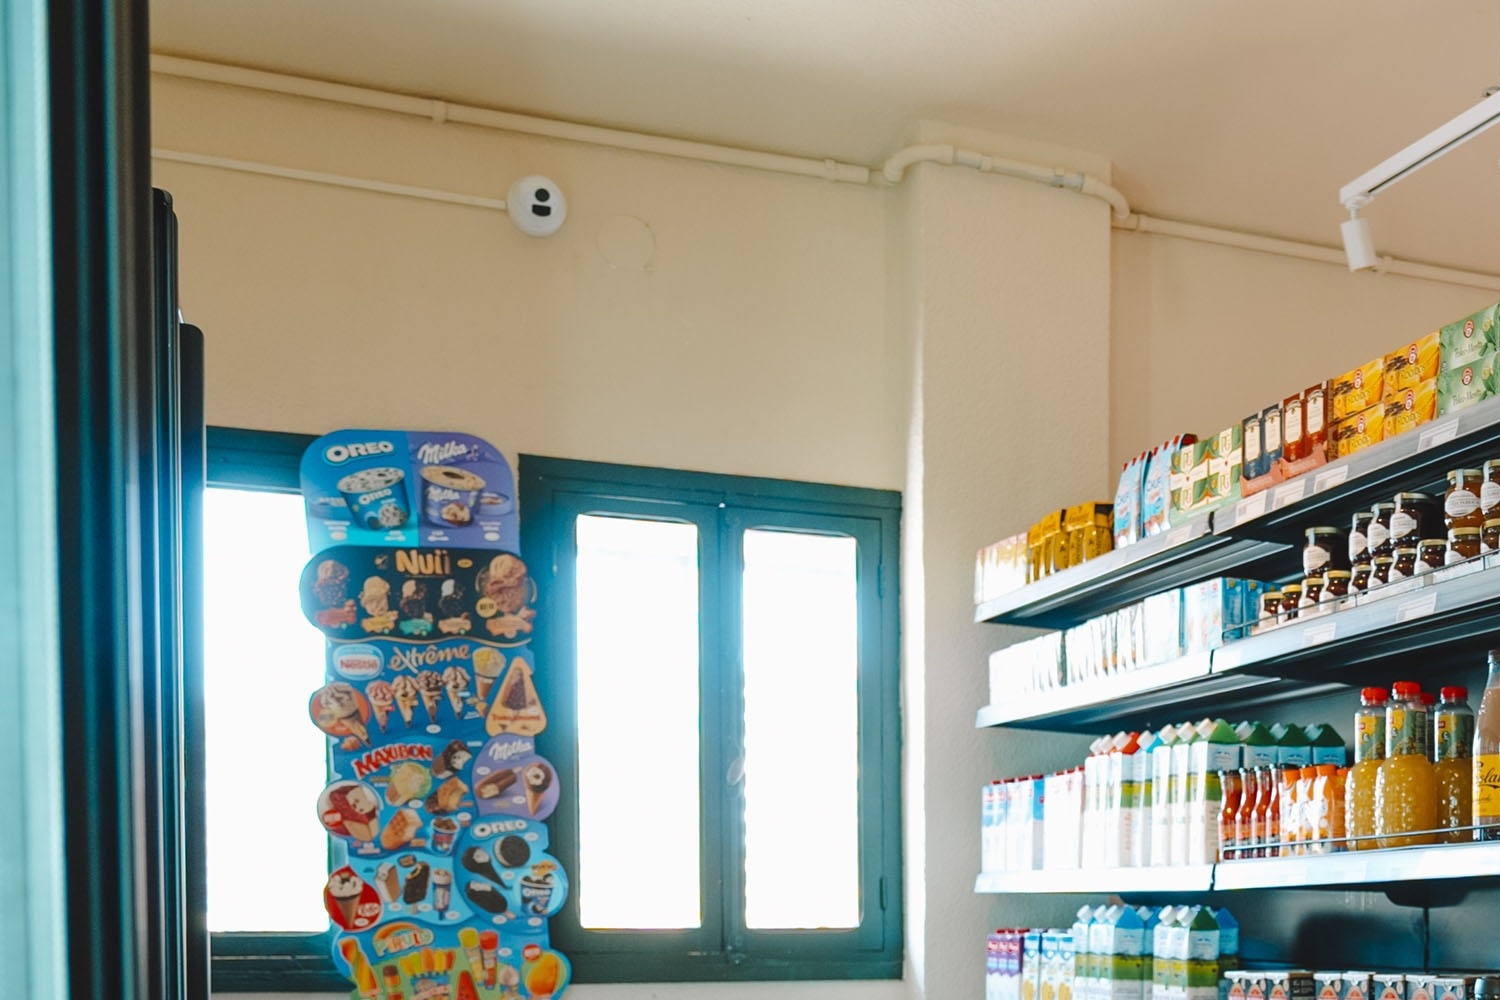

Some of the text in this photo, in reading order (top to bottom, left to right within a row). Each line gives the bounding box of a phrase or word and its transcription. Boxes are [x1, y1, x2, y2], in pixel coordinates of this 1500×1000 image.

[325, 441, 394, 463] OREO
[417, 441, 468, 463] Milka
[358, 488, 393, 505] OREO
[395, 550, 451, 575] Nuii
[354, 743, 433, 777] MAXIBON
[474, 818, 527, 837] OREO
